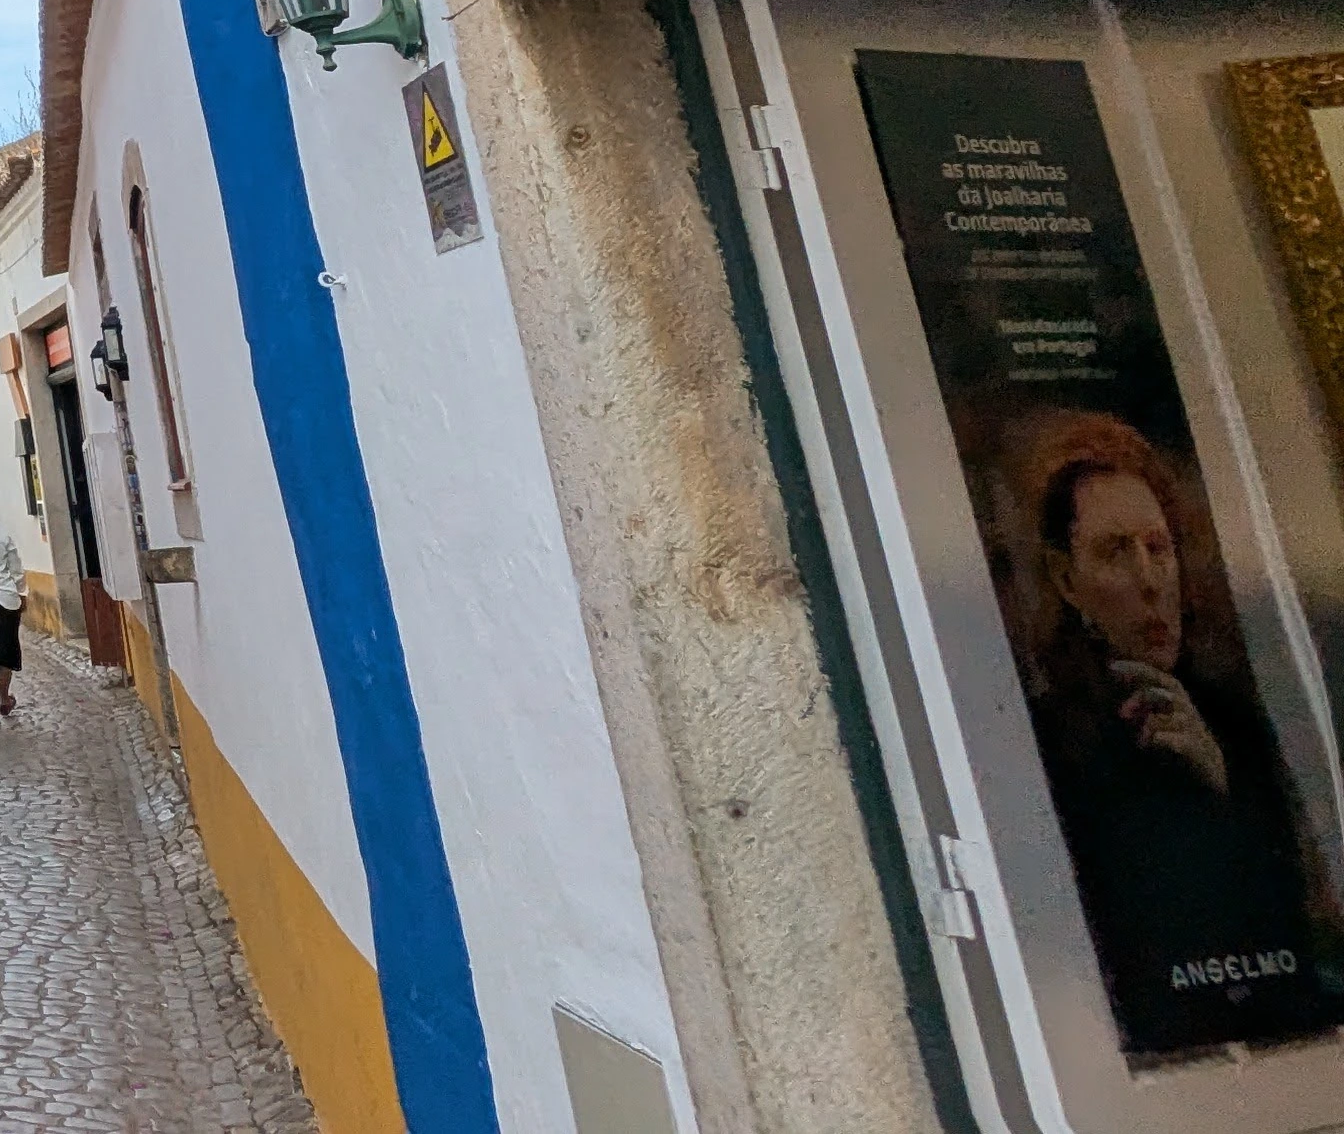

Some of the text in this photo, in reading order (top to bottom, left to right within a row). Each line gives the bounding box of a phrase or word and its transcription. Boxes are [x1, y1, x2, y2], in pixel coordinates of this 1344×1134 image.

[954, 134, 1042, 155] Descubra
[942, 160, 1069, 181] as maravilhas
[957, 185, 983, 206] da
[945, 211, 1094, 237] Contemporânea
[1171, 949, 1298, 991] ANSELMO
